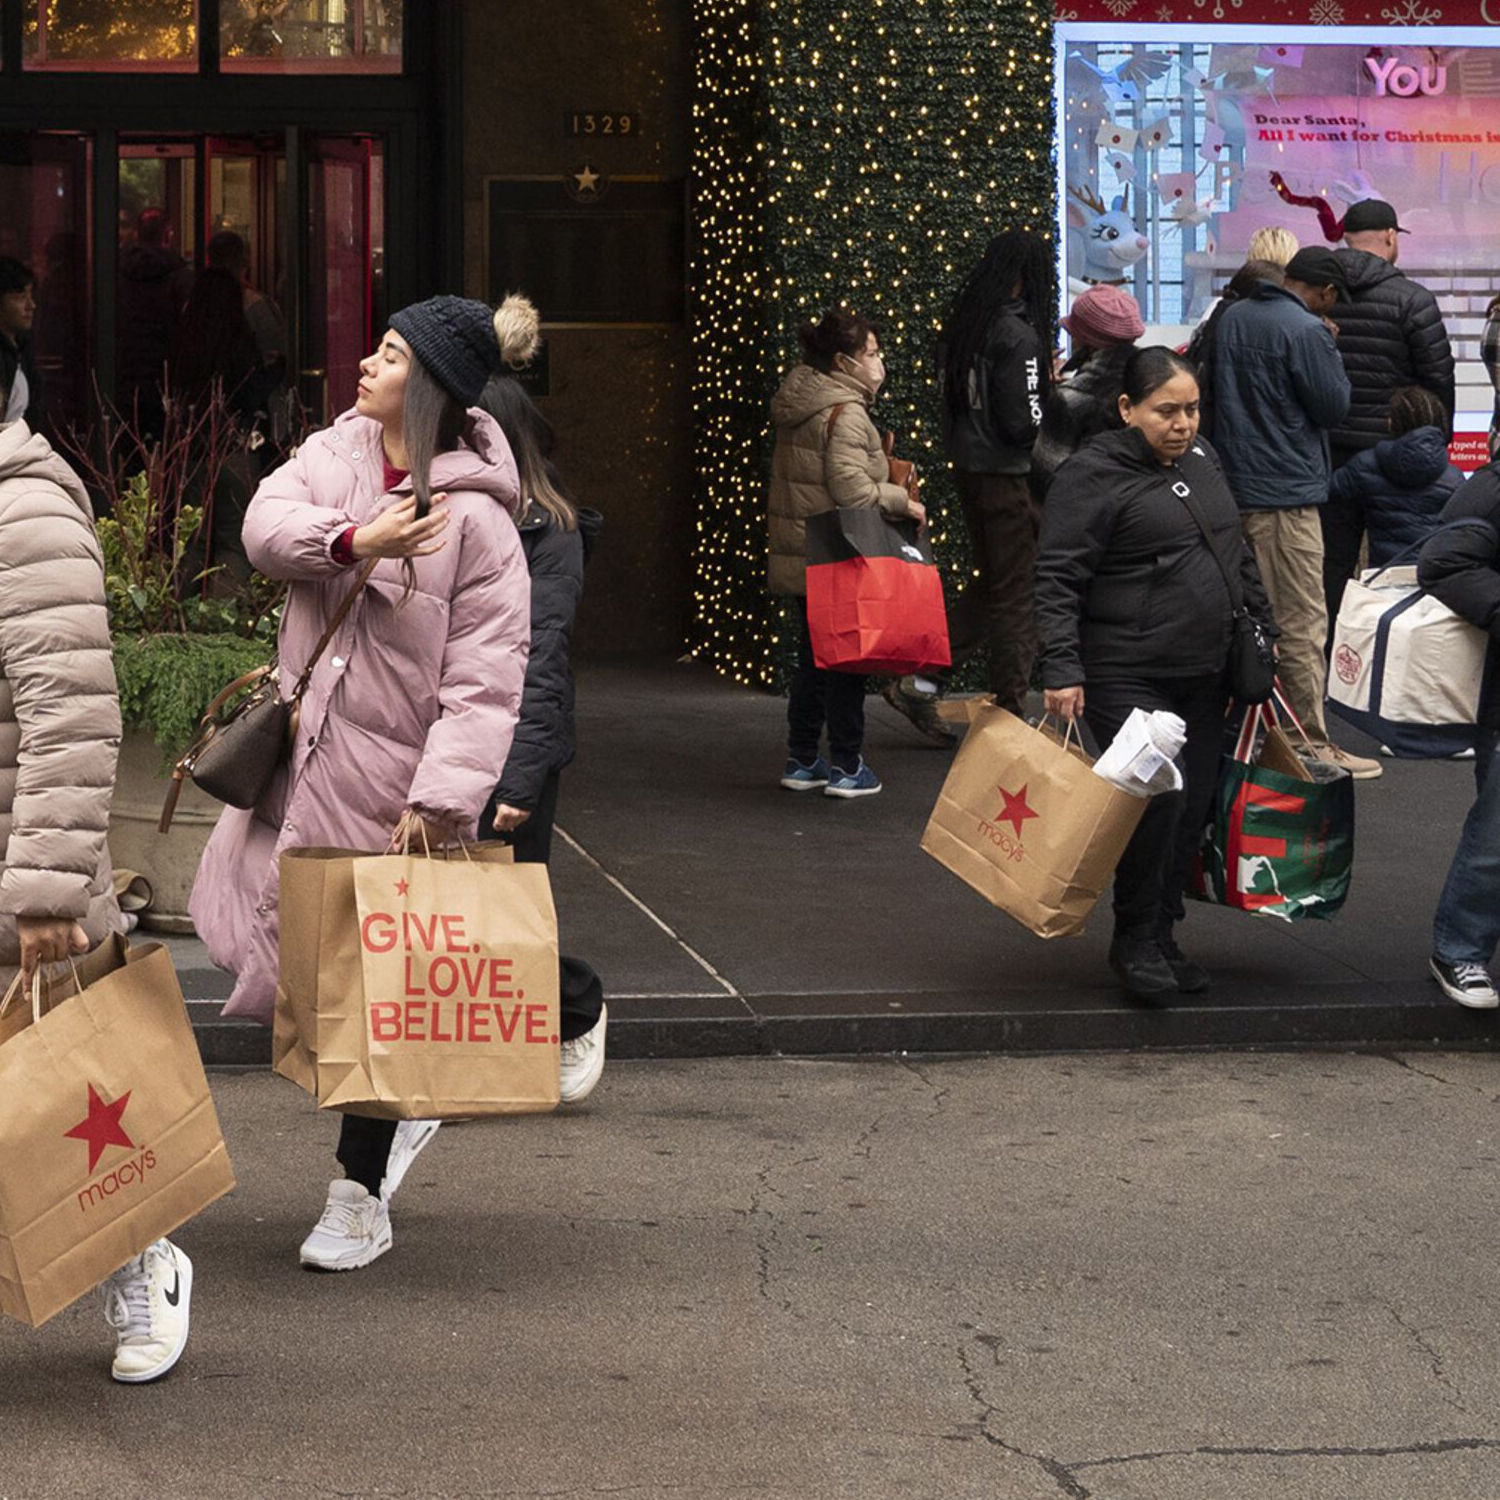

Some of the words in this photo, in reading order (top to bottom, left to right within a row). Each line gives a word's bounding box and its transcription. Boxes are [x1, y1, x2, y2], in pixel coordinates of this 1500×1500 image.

[572, 115, 632, 134] 1329
[1254, 114, 1301, 126] Dear
[1303, 114, 1367, 129] Santa,
[1258, 129, 1284, 141] All
[1287, 129, 1295, 141] I
[1299, 130, 1348, 142] want
[1351, 130, 1380, 142] for
[1384, 130, 1482, 143] Christmas
[1025, 356, 1039, 391] THE
[361, 912, 481, 953] GIVE.
[404, 956, 524, 999] LOVE.
[370, 1001, 560, 1045] BELIEVE.
